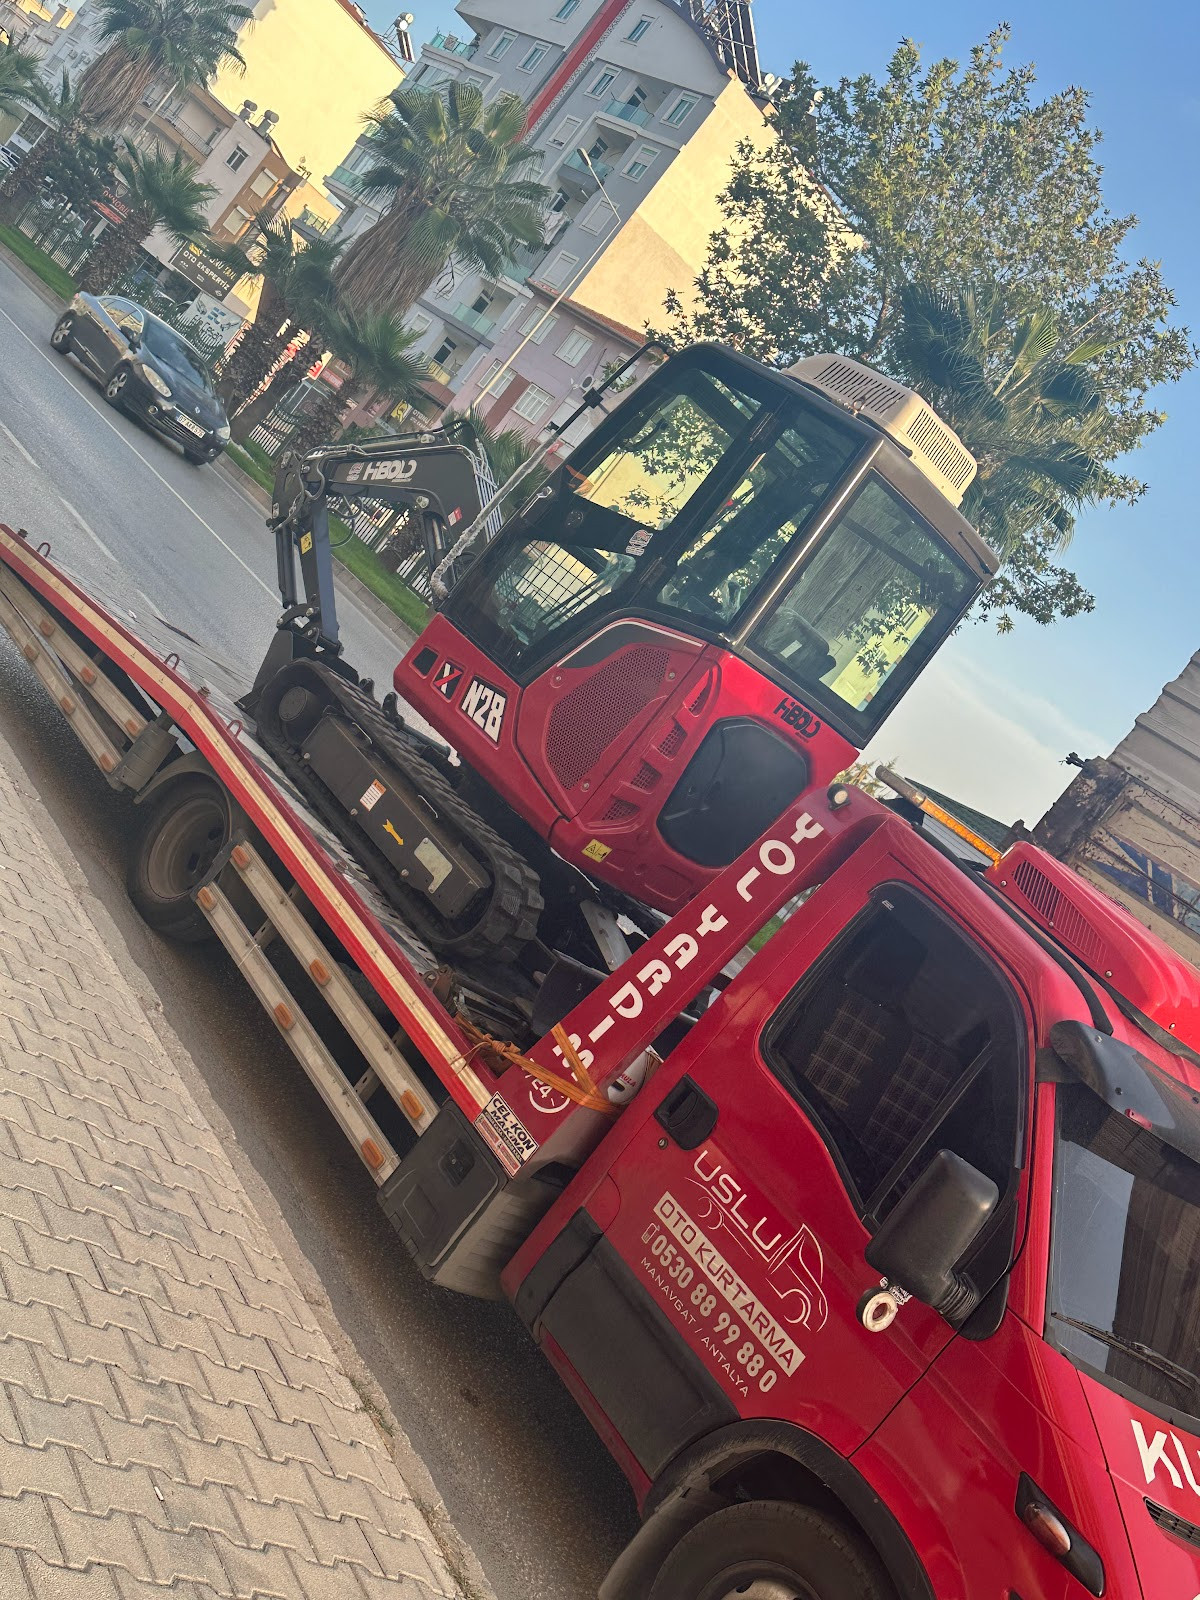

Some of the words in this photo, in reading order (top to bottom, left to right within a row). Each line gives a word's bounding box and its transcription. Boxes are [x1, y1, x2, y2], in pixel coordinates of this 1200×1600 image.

[183, 250, 196, 263] OTO
[461, 680, 506, 743] N28
[736, 812, 824, 902] YOL
[694, 1150, 782, 1250] USLU
[640, 1257, 697, 1325] MANAVGAT
[701, 1336, 749, 1397] ANTALYA
[651, 1235, 694, 1289] 0530
[690, 1283, 717, 1317] 88
[713, 1312, 741, 1345] 99
[736, 1341, 777, 1393] 880
[660, 1199, 697, 1244] OTO
[695, 1242, 797, 1369] KURTARMA
